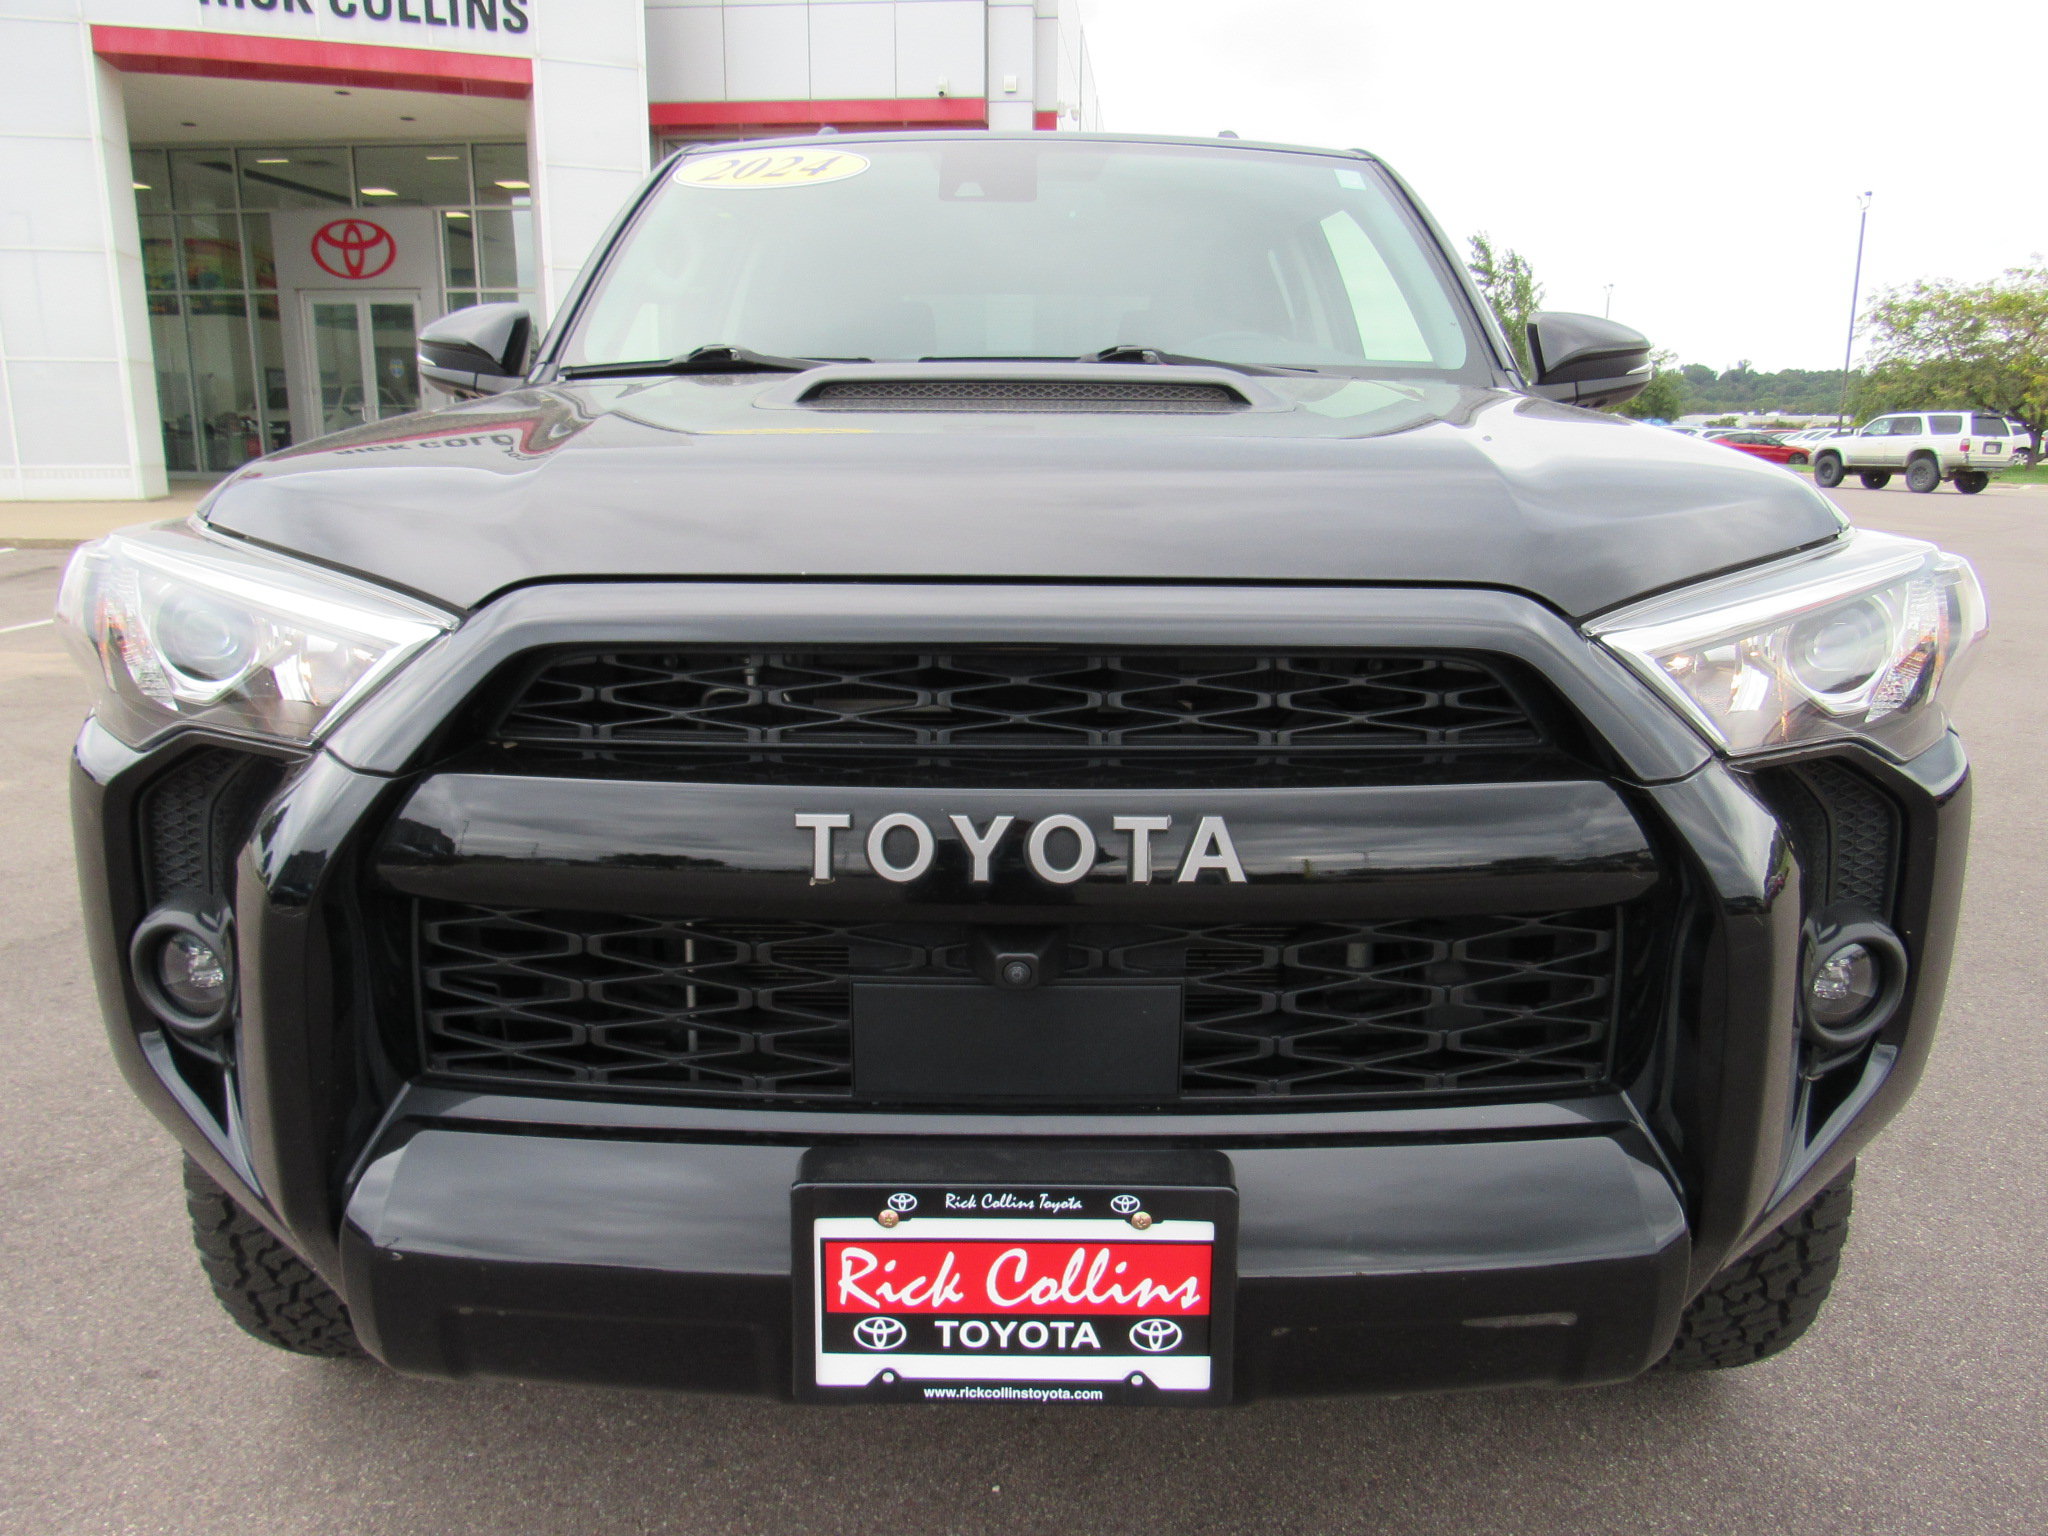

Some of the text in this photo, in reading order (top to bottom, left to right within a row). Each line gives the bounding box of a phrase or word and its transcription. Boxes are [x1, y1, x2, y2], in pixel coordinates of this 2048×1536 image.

[697, 155, 843, 183] 2024
[794, 811, 1248, 885] TOYOTA
[945, 1192, 1083, 1214] Rick Collins Toyota
[838, 1246, 1201, 1310] Rick Collins
[934, 1319, 1102, 1350] TOYOTA
[923, 1386, 1104, 1402] www.rickcollinstoyota.com
